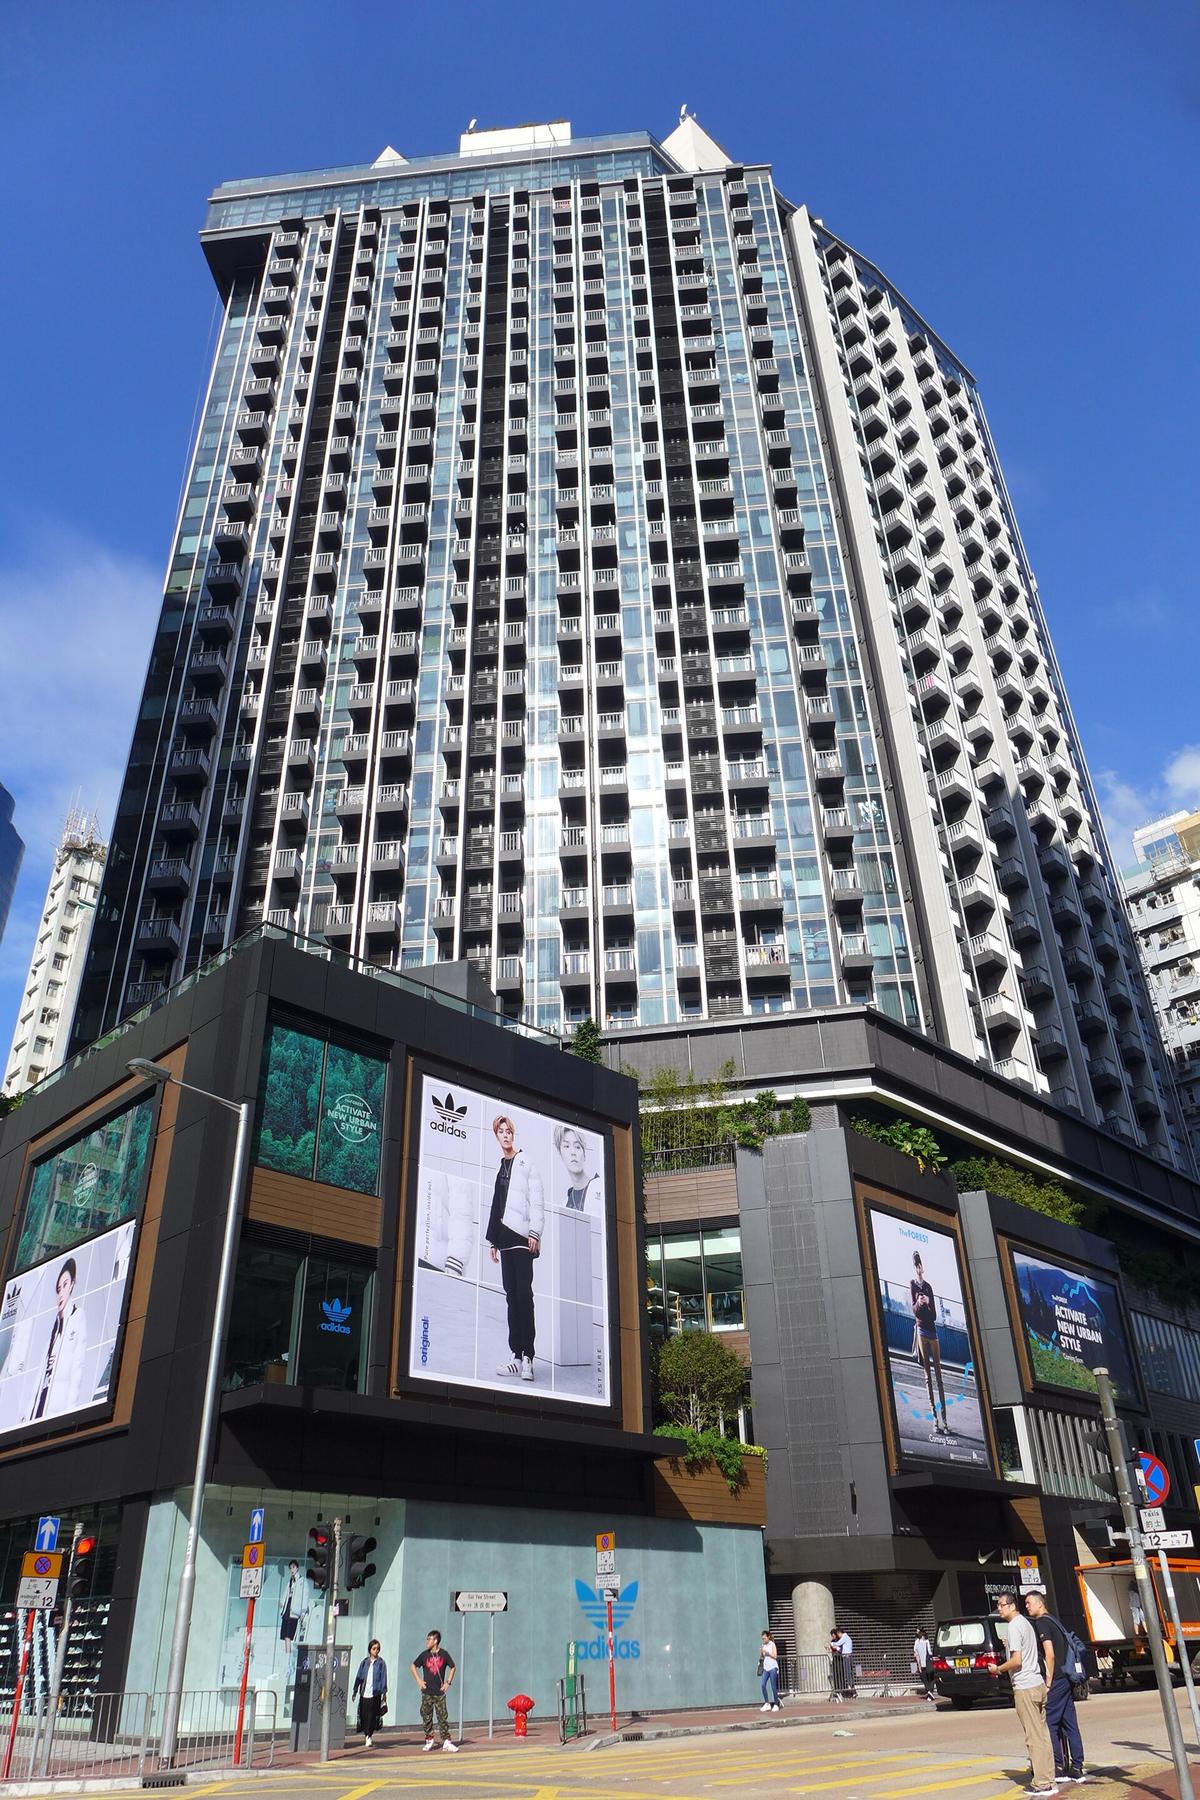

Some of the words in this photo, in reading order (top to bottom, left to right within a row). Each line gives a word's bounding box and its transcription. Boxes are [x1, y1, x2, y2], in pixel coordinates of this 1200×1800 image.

[335, 1103, 371, 1120] ACTIVATE
[327, 1109, 347, 1121] NEW
[349, 1115, 377, 1130] URBAN
[340, 1122, 363, 1135] STYLE
[430, 1121, 467, 1139] adidas
[1055, 1304, 1087, 1326] ACTIVATE
[321, 1322, 351, 1334] adidas
[1057, 1319, 1075, 1336] NEW
[1076, 1325, 1103, 1344] URBAN
[1060, 1334, 1082, 1352] STYLE
[928, 1433, 946, 1446] Coming
[946, 1436, 958, 1446] Soon
[1181, 1533, 1189, 1545] 7
[254, 1569, 259, 1579] 7
[44, 1580, 52, 1590] 7
[253, 1584, 260, 1595] 12
[42, 1596, 53, 1607] 12
[577, 1634, 641, 1660] adidas
